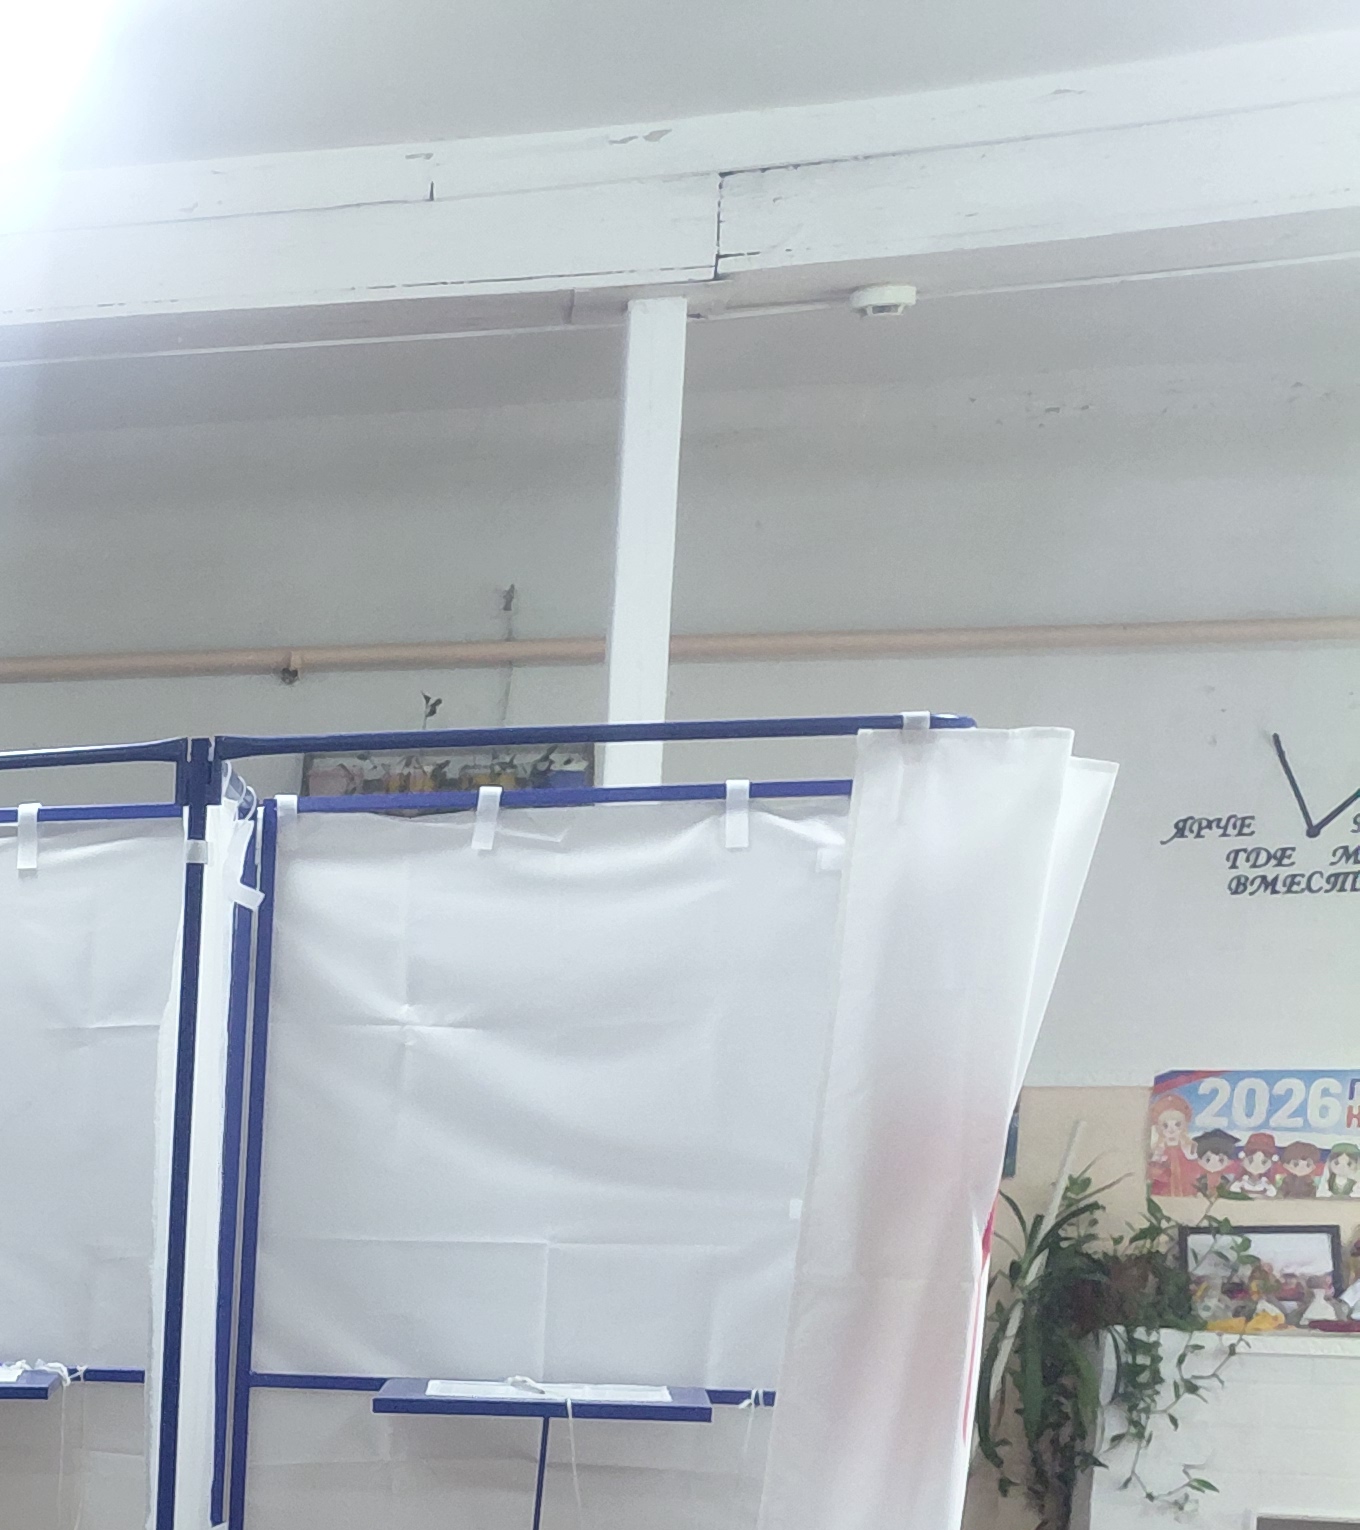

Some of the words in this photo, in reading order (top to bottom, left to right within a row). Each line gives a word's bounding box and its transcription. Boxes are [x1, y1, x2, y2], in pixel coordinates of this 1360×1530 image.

[1159, 814, 1255, 845] ЯРЧЕ
[1226, 846, 1296, 870] ГДЕ
[1329, 845, 1360, 866] М
[1228, 870, 1360, 896] ВМЕСТ
[1195, 1077, 1342, 1128] 2026
